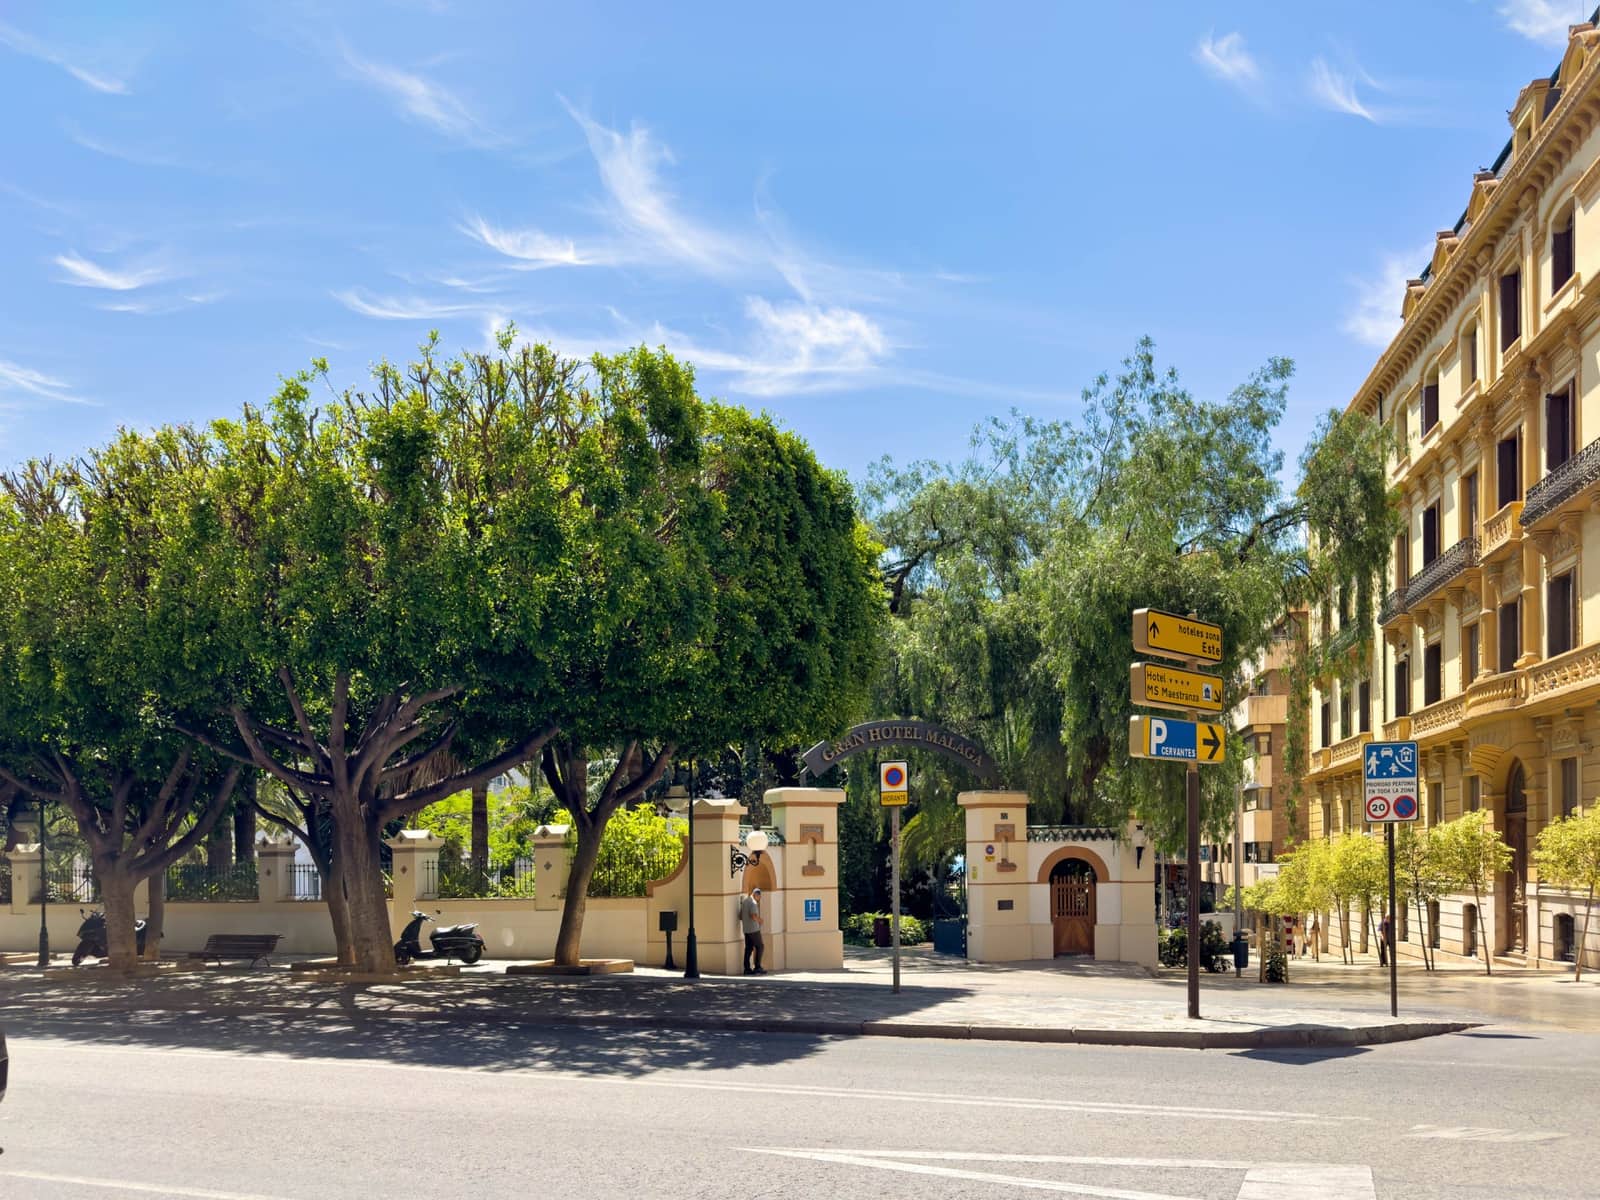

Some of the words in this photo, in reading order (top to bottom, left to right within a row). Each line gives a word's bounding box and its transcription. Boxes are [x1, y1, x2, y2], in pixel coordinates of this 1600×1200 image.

[1178, 624, 1204, 638] hoteles
[1205, 630, 1220, 641] zona
[1202, 642, 1220, 656] Este
[1147, 671, 1166, 683] Hotel
[1147, 685, 1159, 696] MS
[1161, 687, 1199, 703] Maestranza
[822, 732, 865, 761] GRAN
[869, 727, 922, 742] HOTEL
[1150, 719, 1167, 755] P
[1161, 746, 1195, 758] CERVANTES
[1371, 803, 1385, 812] 20
[809, 902, 816, 912] H
